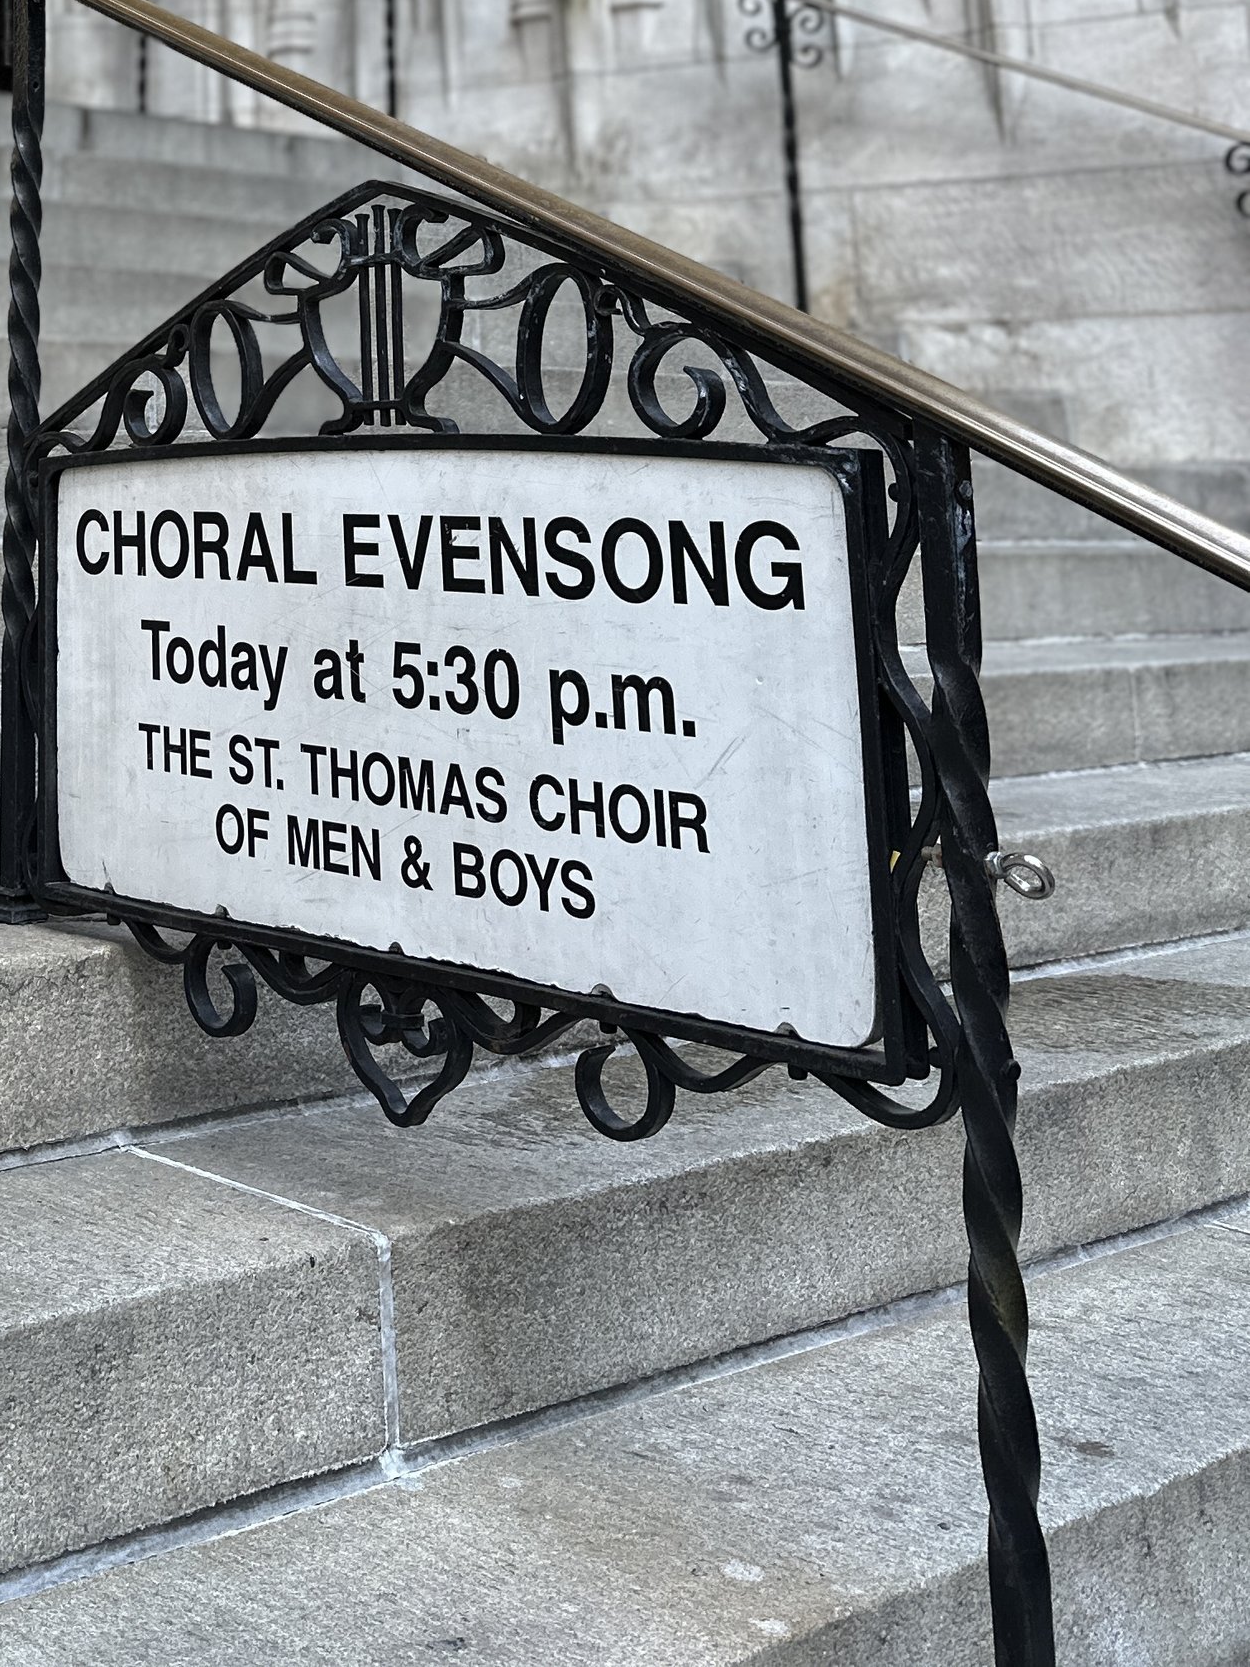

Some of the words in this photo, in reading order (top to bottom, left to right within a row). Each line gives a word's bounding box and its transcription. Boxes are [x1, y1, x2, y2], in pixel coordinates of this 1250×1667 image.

[77, 509, 317, 584] CHORAL
[343, 514, 805, 610] EVENSONG
[141, 620, 288, 711] Today
[314, 640, 366, 703] at
[393, 642, 519, 719] 5:30
[549, 670, 696, 745] p.m.
[139, 723, 212, 778] THE
[229, 735, 283, 790] ST.
[301, 743, 507, 823] THOMAS
[530, 774, 710, 853] CHOIR
[216, 804, 269, 857] OF
[287, 815, 381, 881] MEN
[401, 835, 433, 890] &
[453, 842, 595, 919] BOYS
